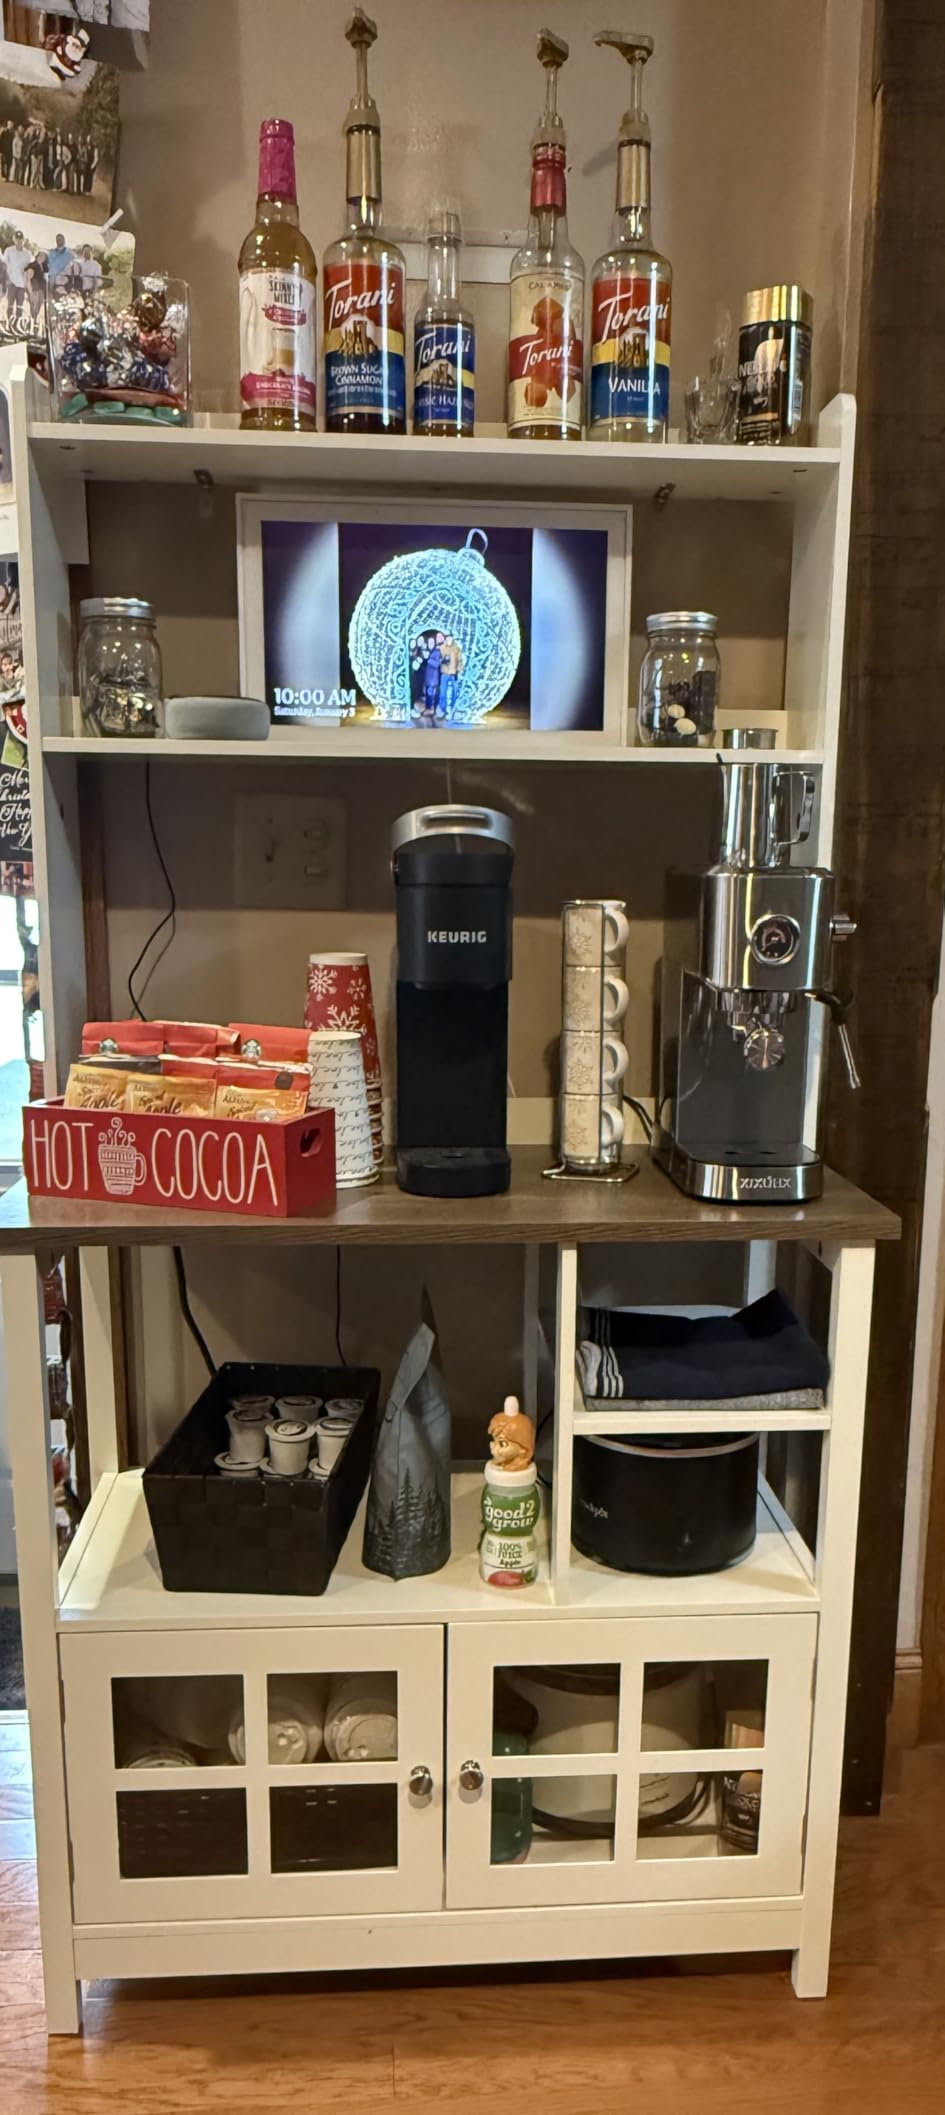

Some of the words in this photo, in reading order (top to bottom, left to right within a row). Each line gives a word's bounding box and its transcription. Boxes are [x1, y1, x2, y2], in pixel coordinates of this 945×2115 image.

[325, 278, 396, 331] Torani
[598, 291, 670, 343] Torani
[415, 332, 471, 375] Torani
[519, 338, 574, 375] Torani
[360, 362, 386, 375] SUG
[335, 374, 383, 386] CINNAMON
[608, 377, 661, 396] VANILA
[274, 687, 325, 705] 10:00
[327, 688, 356, 706] AM
[427, 930, 487, 943] KEURIG
[30, 1119, 94, 1192] HOT
[151, 1127, 278, 1206] COCOA
[492, 1517, 533, 1532] grow
